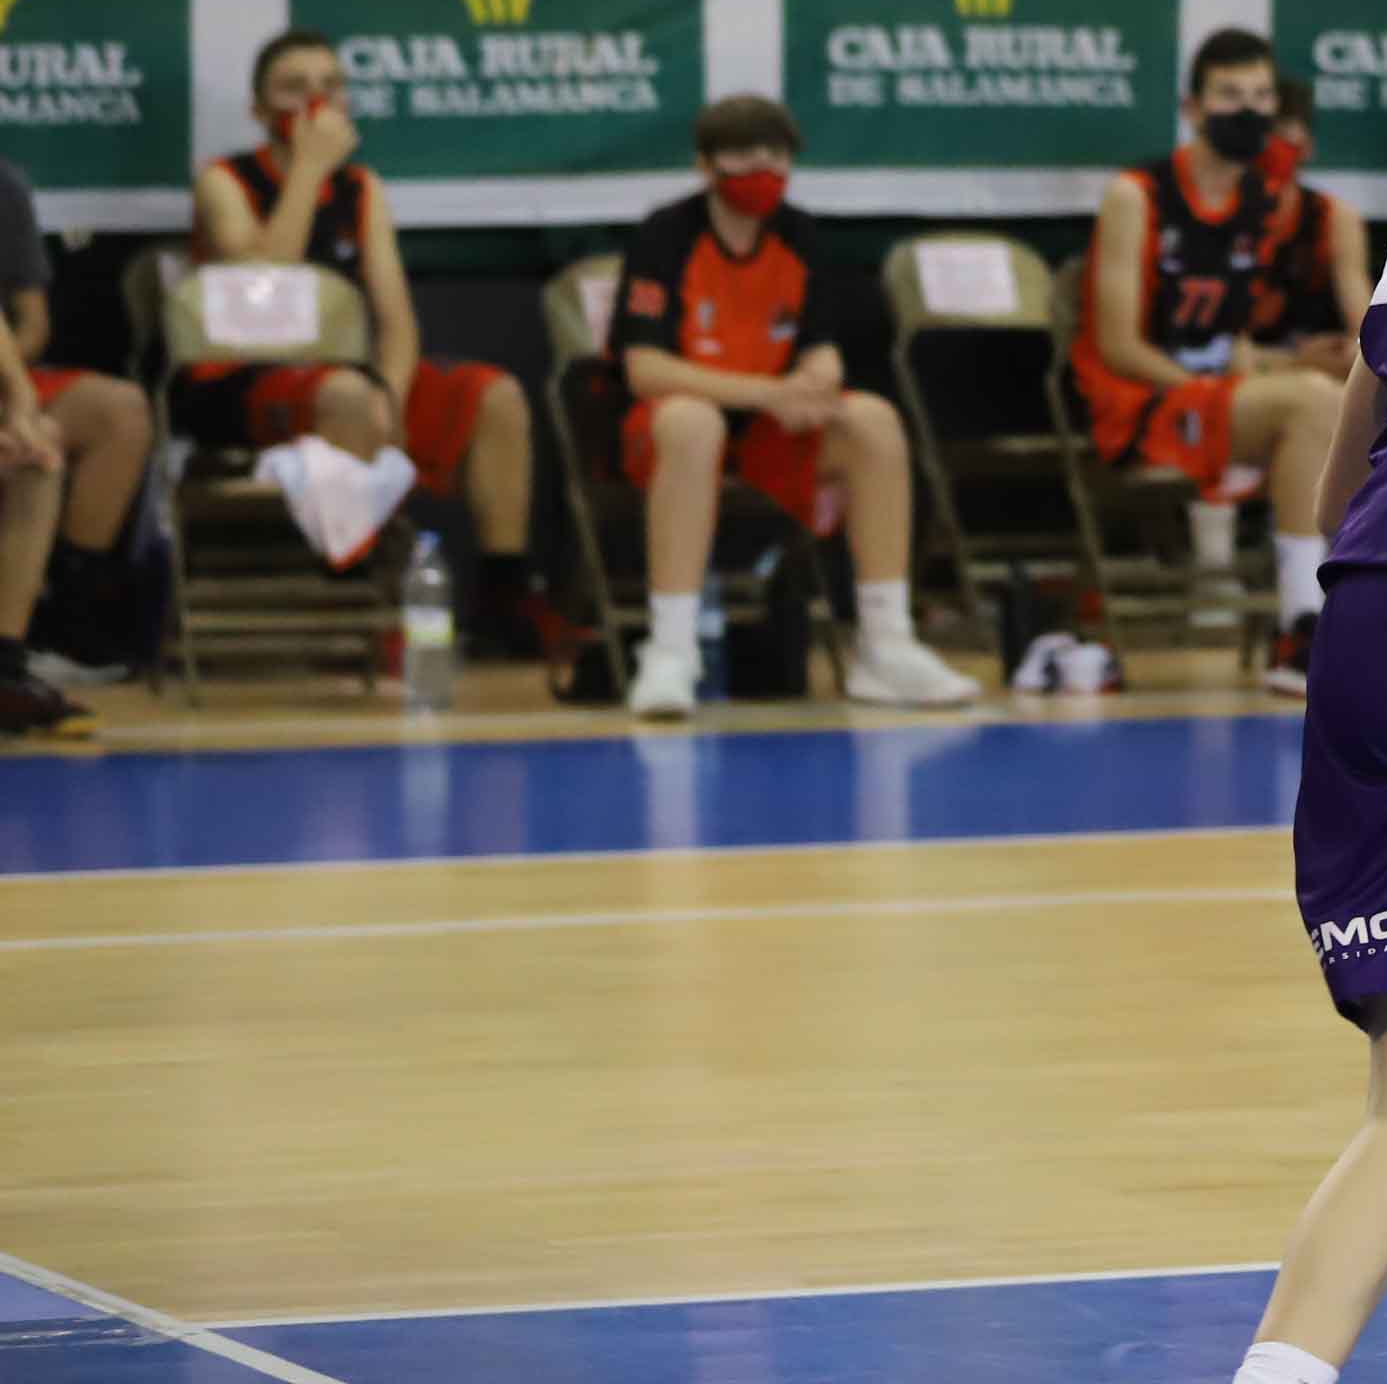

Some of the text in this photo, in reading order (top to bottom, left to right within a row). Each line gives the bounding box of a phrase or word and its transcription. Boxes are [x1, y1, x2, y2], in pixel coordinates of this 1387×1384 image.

[340, 29, 661, 81] CAJA RURAL
[826, 23, 1138, 72] CAJA RURAL
[411, 79, 660, 117] SALAMANCA
[826, 71, 1135, 108] DE SALAMANCA
[1313, 75, 1365, 109] DE
